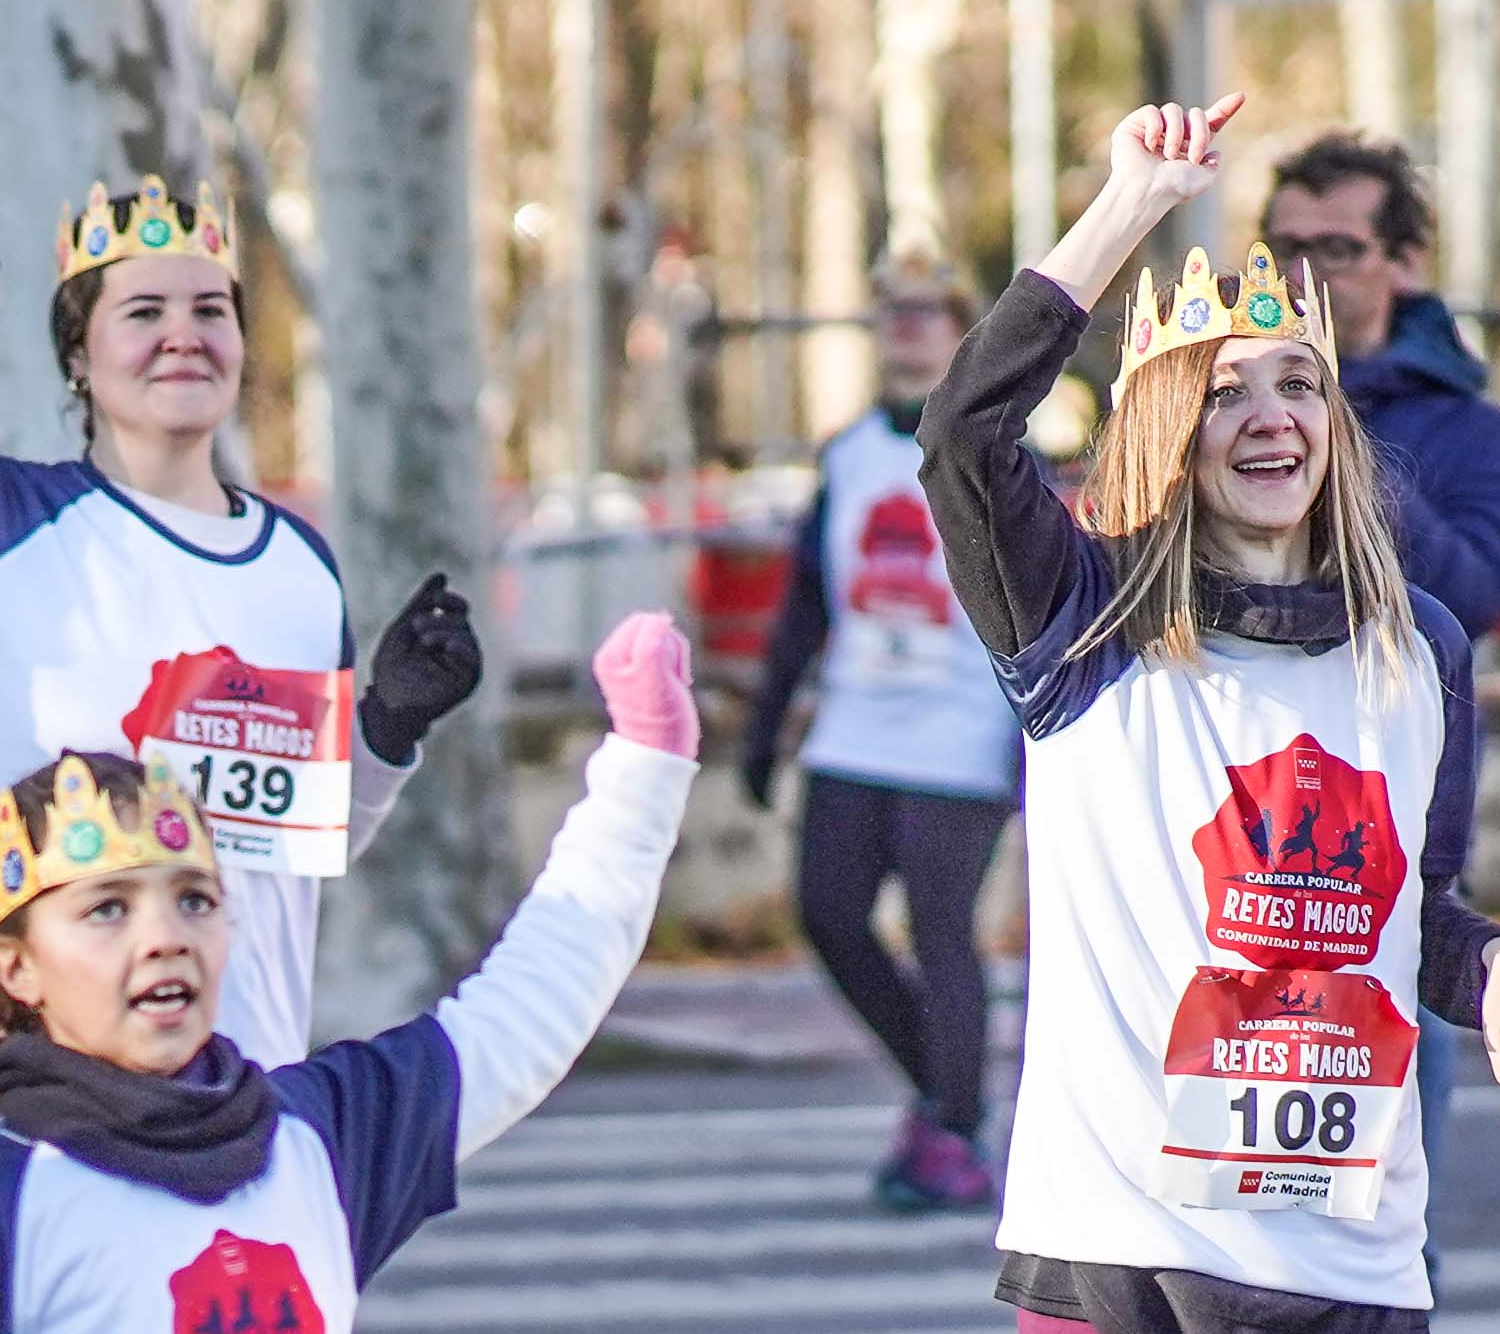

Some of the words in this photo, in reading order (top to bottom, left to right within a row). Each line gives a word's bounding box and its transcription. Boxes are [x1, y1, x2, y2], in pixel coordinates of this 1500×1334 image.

[190, 754, 295, 816] 139
[1245, 871, 1304, 886] CARRERA
[1307, 875, 1362, 895] POPULAR
[1221, 887, 1295, 930] REYES
[1303, 900, 1373, 935] MAGOS
[1216, 927, 1300, 950] COMUNIDAD
[1303, 940, 1321, 952] DE
[1322, 942, 1368, 956] MADRID
[1238, 1019, 1300, 1031] CARRERA
[1302, 1020, 1356, 1039] POPULAR
[1212, 1037, 1289, 1075] REYES
[1299, 1042, 1372, 1078] MAGOS
[1230, 1086, 1357, 1154] 108
[1261, 1183, 1276, 1194] de
[1280, 1183, 1329, 1198] Madrid
[1265, 1171, 1332, 1185] Comunidad
